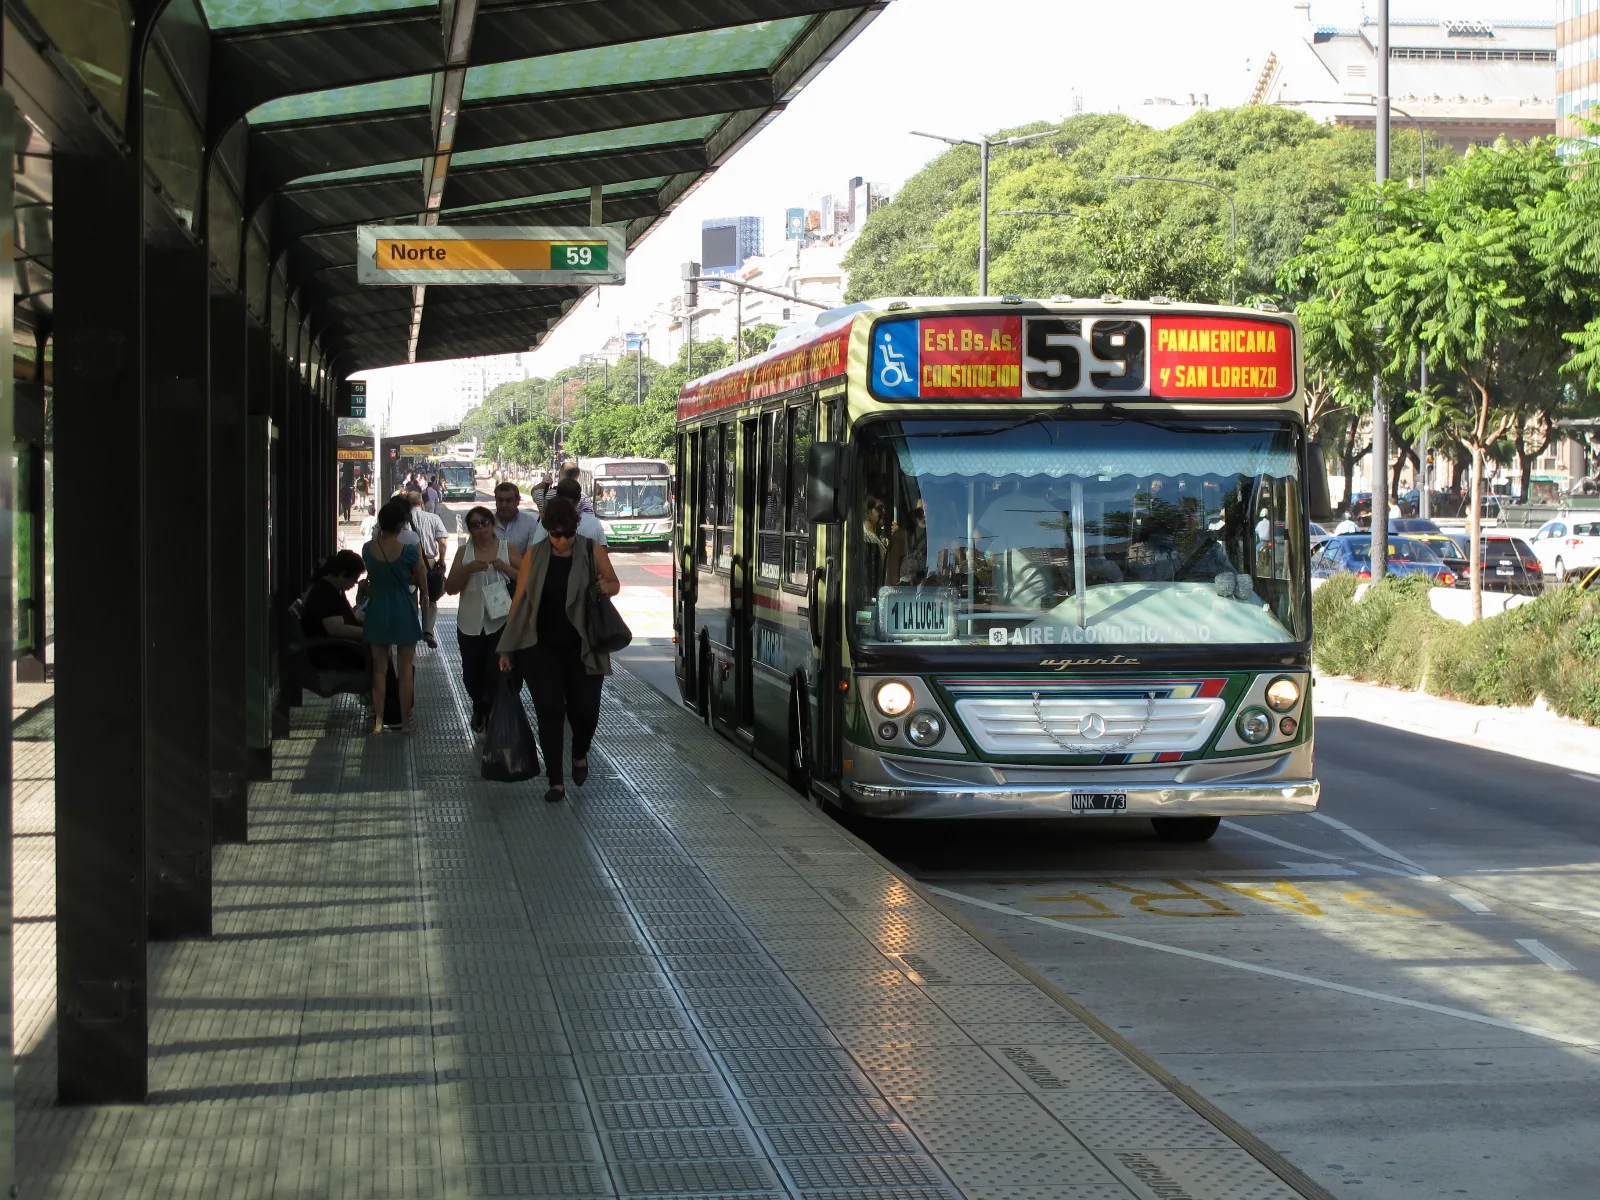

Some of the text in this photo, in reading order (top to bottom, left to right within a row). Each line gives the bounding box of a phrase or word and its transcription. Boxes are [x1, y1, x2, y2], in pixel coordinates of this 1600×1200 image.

[391, 243, 447, 260] Norte
[566, 246, 592, 266] 59
[1157, 328, 1277, 353] PANAMERICANA
[1026, 319, 1146, 391] 59
[923, 364, 1020, 388] CONSTITUCION
[1175, 365, 1208, 388] SAN
[1211, 366, 1278, 389] LORENZO
[891, 601, 945, 630] 1 LA LUCILA
[1011, 624, 1211, 645] AIRE ACONDICIOAO
[1039, 654, 1141, 671] ugarte
[1073, 794, 1125, 809] NNK 773
